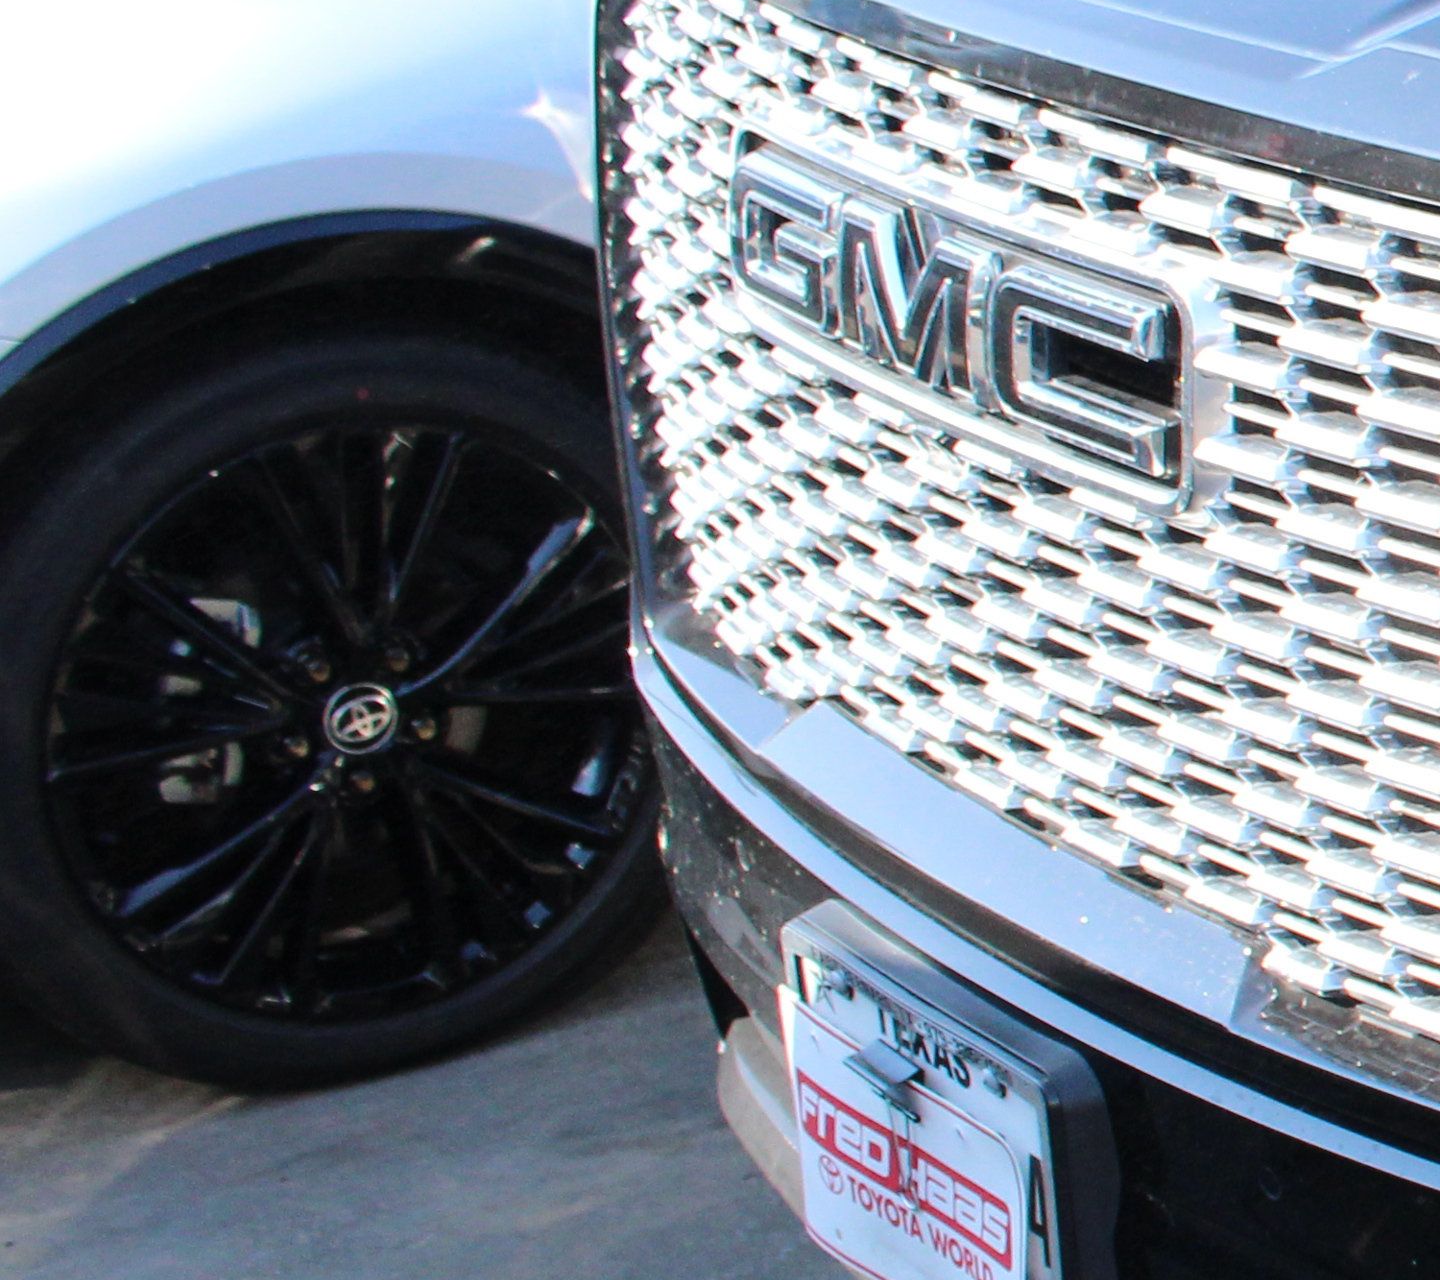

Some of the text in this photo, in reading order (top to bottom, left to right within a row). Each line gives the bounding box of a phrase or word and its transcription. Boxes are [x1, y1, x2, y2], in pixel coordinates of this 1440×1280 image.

[730, 146, 1168, 480] GMC
[877, 1005, 972, 1089] TEXAS
[847, 1175, 926, 1244] TOYOTA
